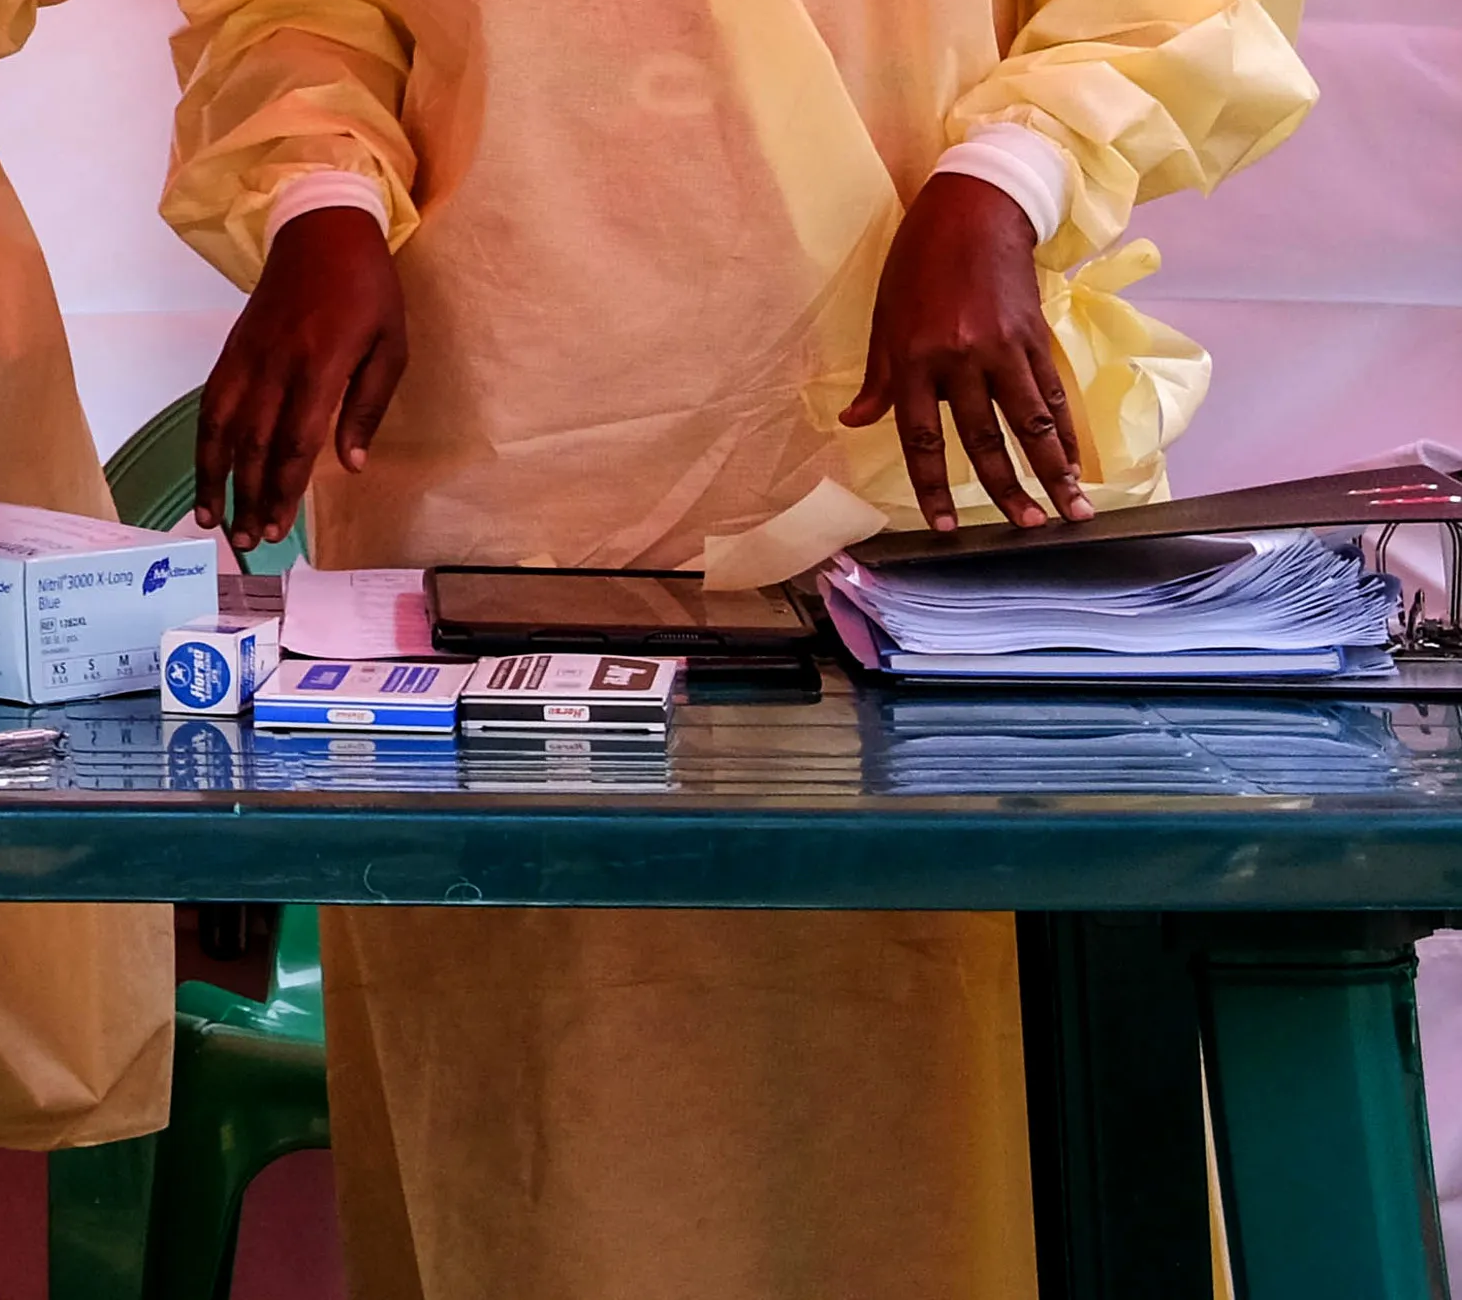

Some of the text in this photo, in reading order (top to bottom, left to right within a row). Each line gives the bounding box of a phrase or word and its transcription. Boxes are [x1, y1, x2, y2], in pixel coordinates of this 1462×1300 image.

[68, 572, 94, 590] 3000
[96, 571, 134, 587] X-Long
[38, 596, 61, 611] Blue
[52, 662, 67, 675] XS
[88, 658, 95, 671] S
[119, 654, 130, 667] M
